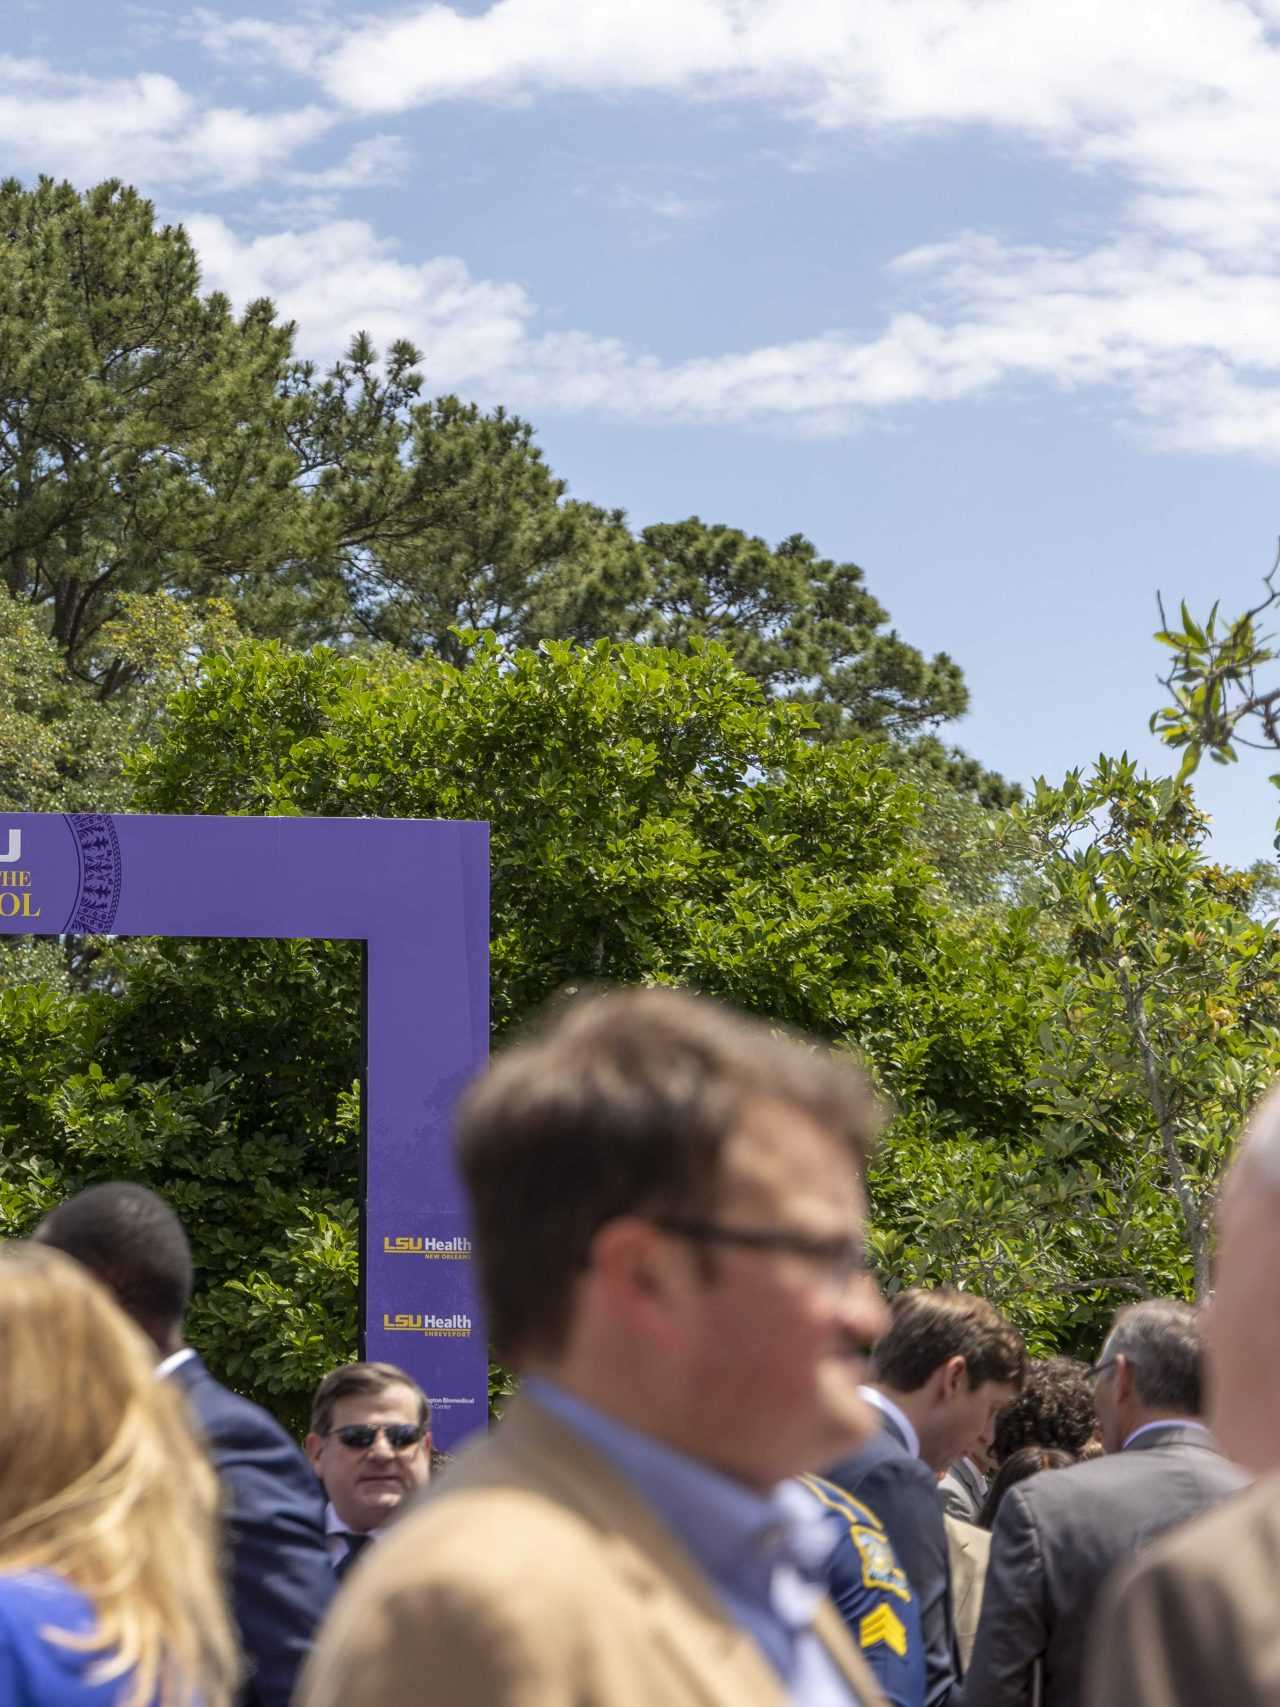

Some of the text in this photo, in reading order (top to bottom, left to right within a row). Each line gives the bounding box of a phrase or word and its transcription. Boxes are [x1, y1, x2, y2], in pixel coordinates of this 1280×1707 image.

[383, 1237, 472, 1251] LSU Health
[383, 1314, 472, 1328] LSU Health
